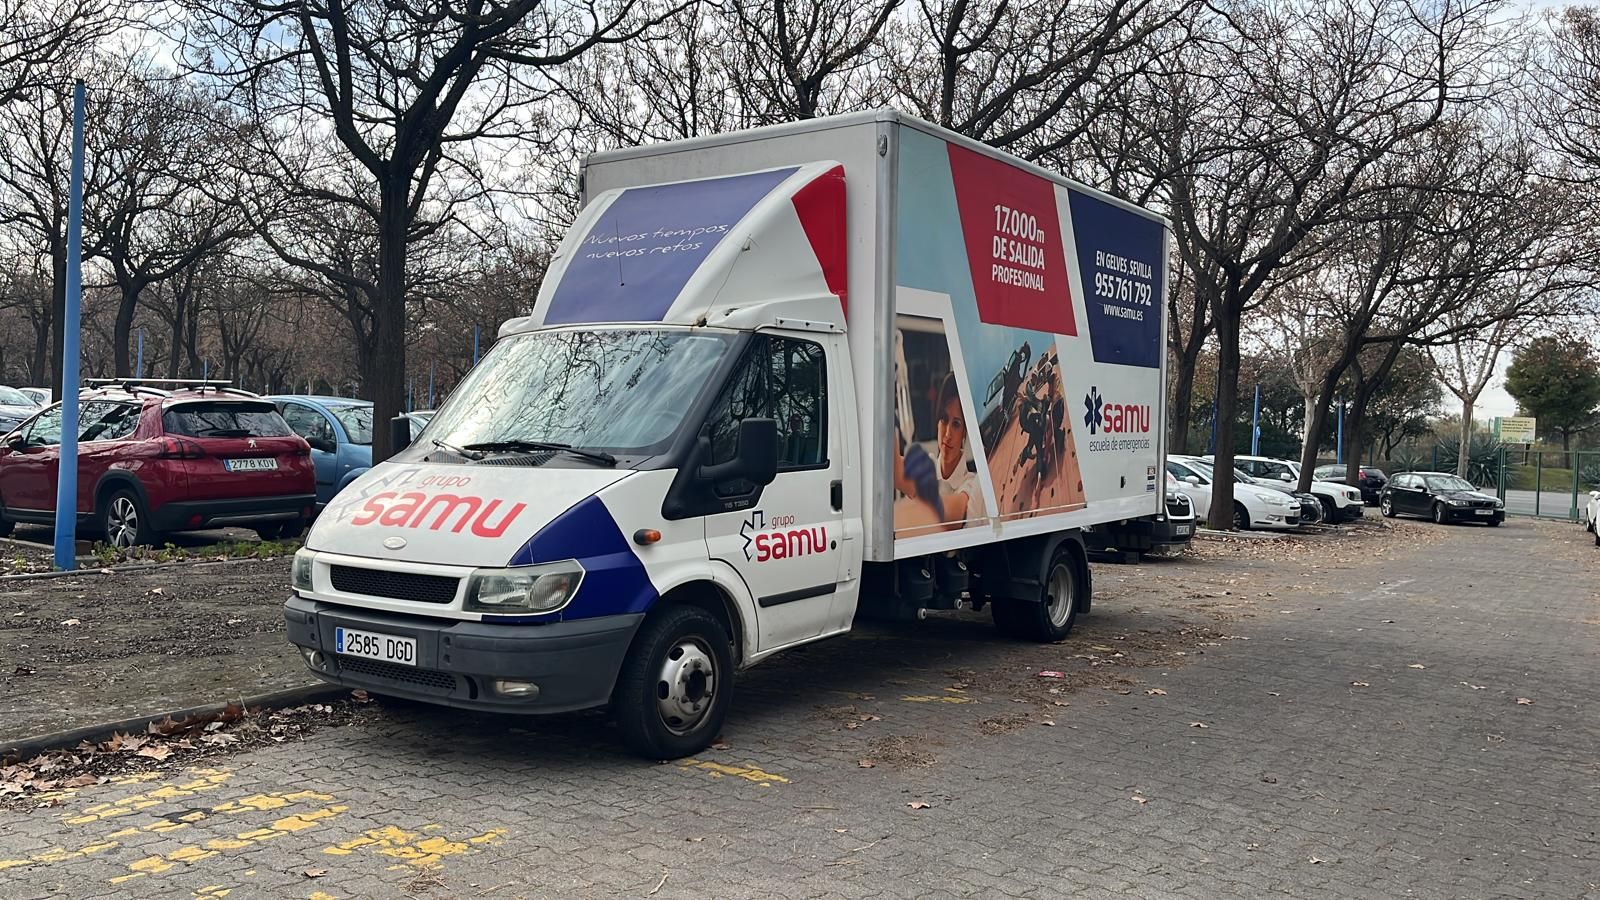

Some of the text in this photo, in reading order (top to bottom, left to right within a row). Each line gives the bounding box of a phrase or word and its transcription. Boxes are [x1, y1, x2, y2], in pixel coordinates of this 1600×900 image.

[583, 232, 648, 244] Nuevos
[586, 239, 704, 259] nuevos retos
[992, 235, 1046, 270] DE SALIDA
[991, 263, 1045, 292] PROFESIONAL
[1096, 250, 1106, 267] EN
[1129, 260, 1152, 280] SEVILLA
[1095, 272, 1152, 306] 955 761 792
[1103, 303, 1144, 321] www.samu.es
[1103, 403, 1150, 433] samu
[1089, 436, 1150, 453] escuela de emergencias
[231, 460, 256, 469] 2778
[416, 474, 472, 489] grupo
[351, 491, 528, 538] samu
[771, 515, 795, 530] grupo
[755, 526, 827, 562] samu
[346, 632, 380, 656] 2585
[386, 638, 413, 662] DGD
